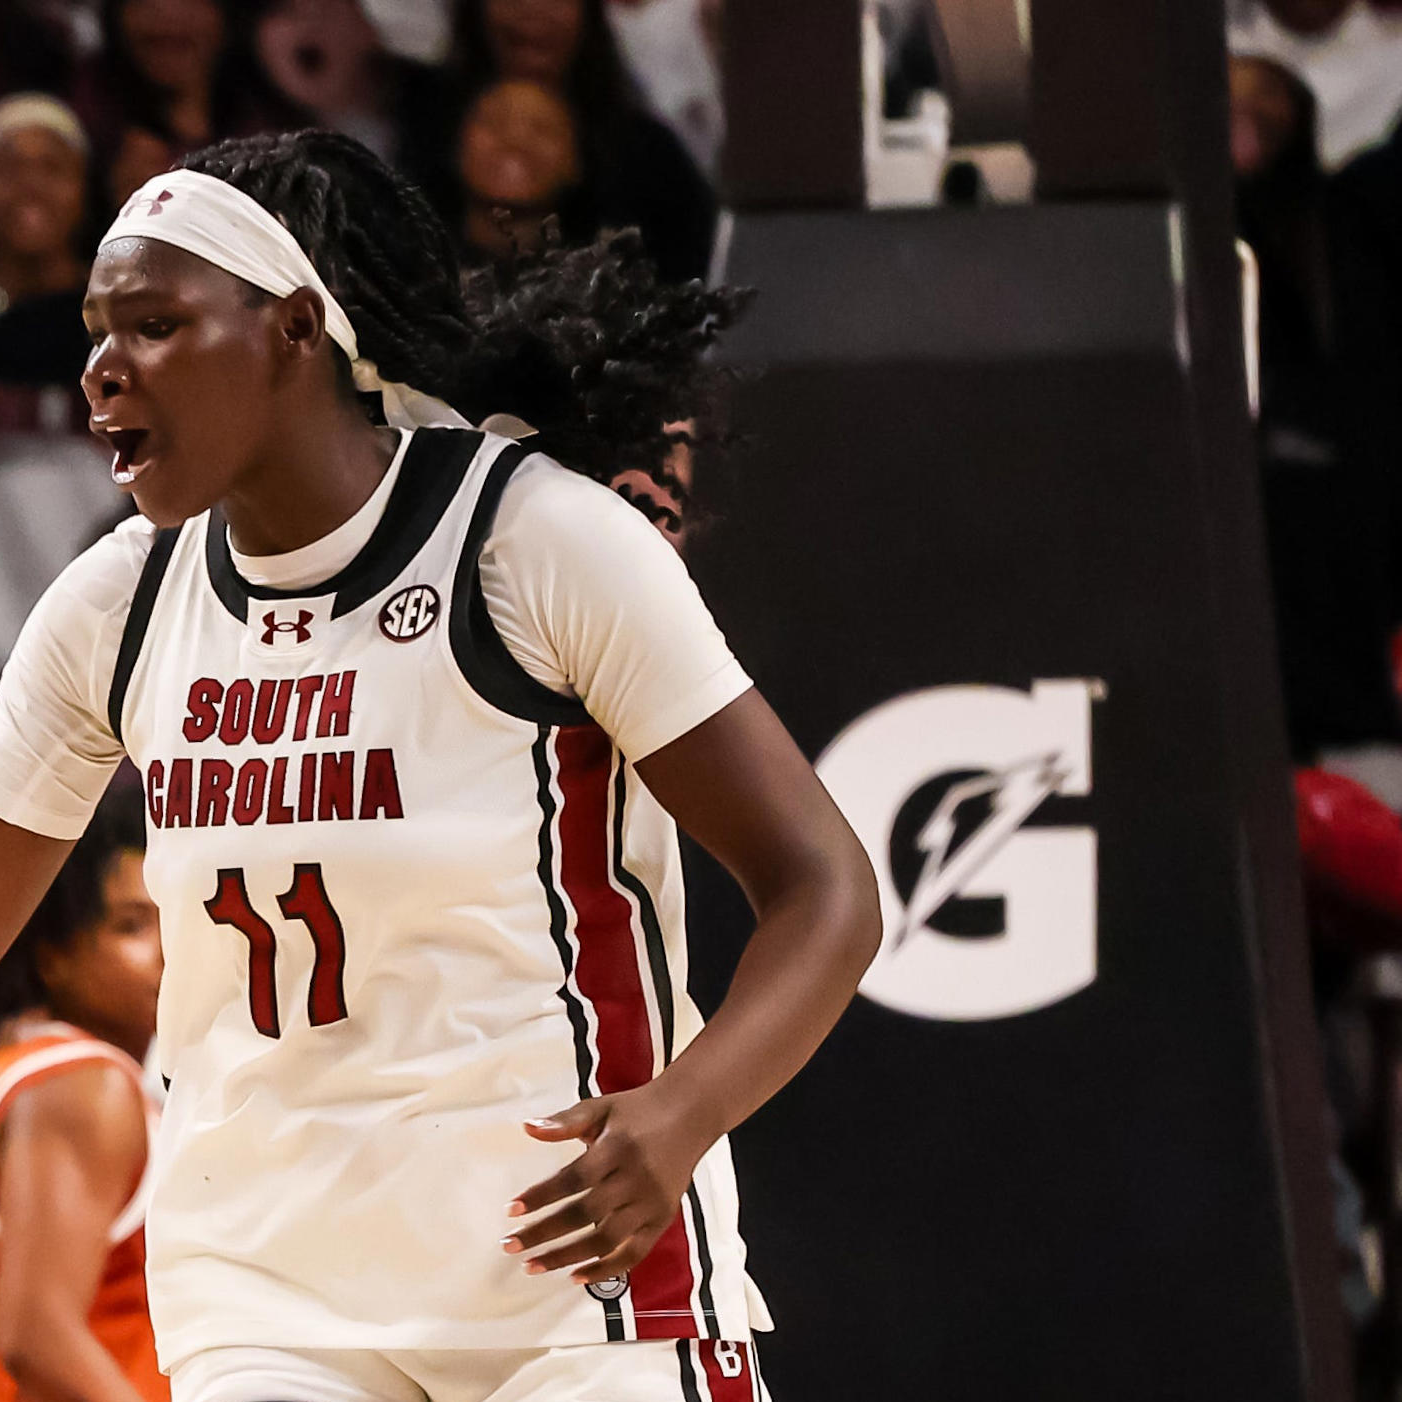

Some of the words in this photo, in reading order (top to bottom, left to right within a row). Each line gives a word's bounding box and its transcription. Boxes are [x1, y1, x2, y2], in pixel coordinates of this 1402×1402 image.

[383, 587, 437, 638] SEC
[181, 669, 357, 746] SOUTH
[147, 747, 405, 829] CAROLINA
[813, 677, 1099, 1023] G
[202, 862, 350, 1040] 11
